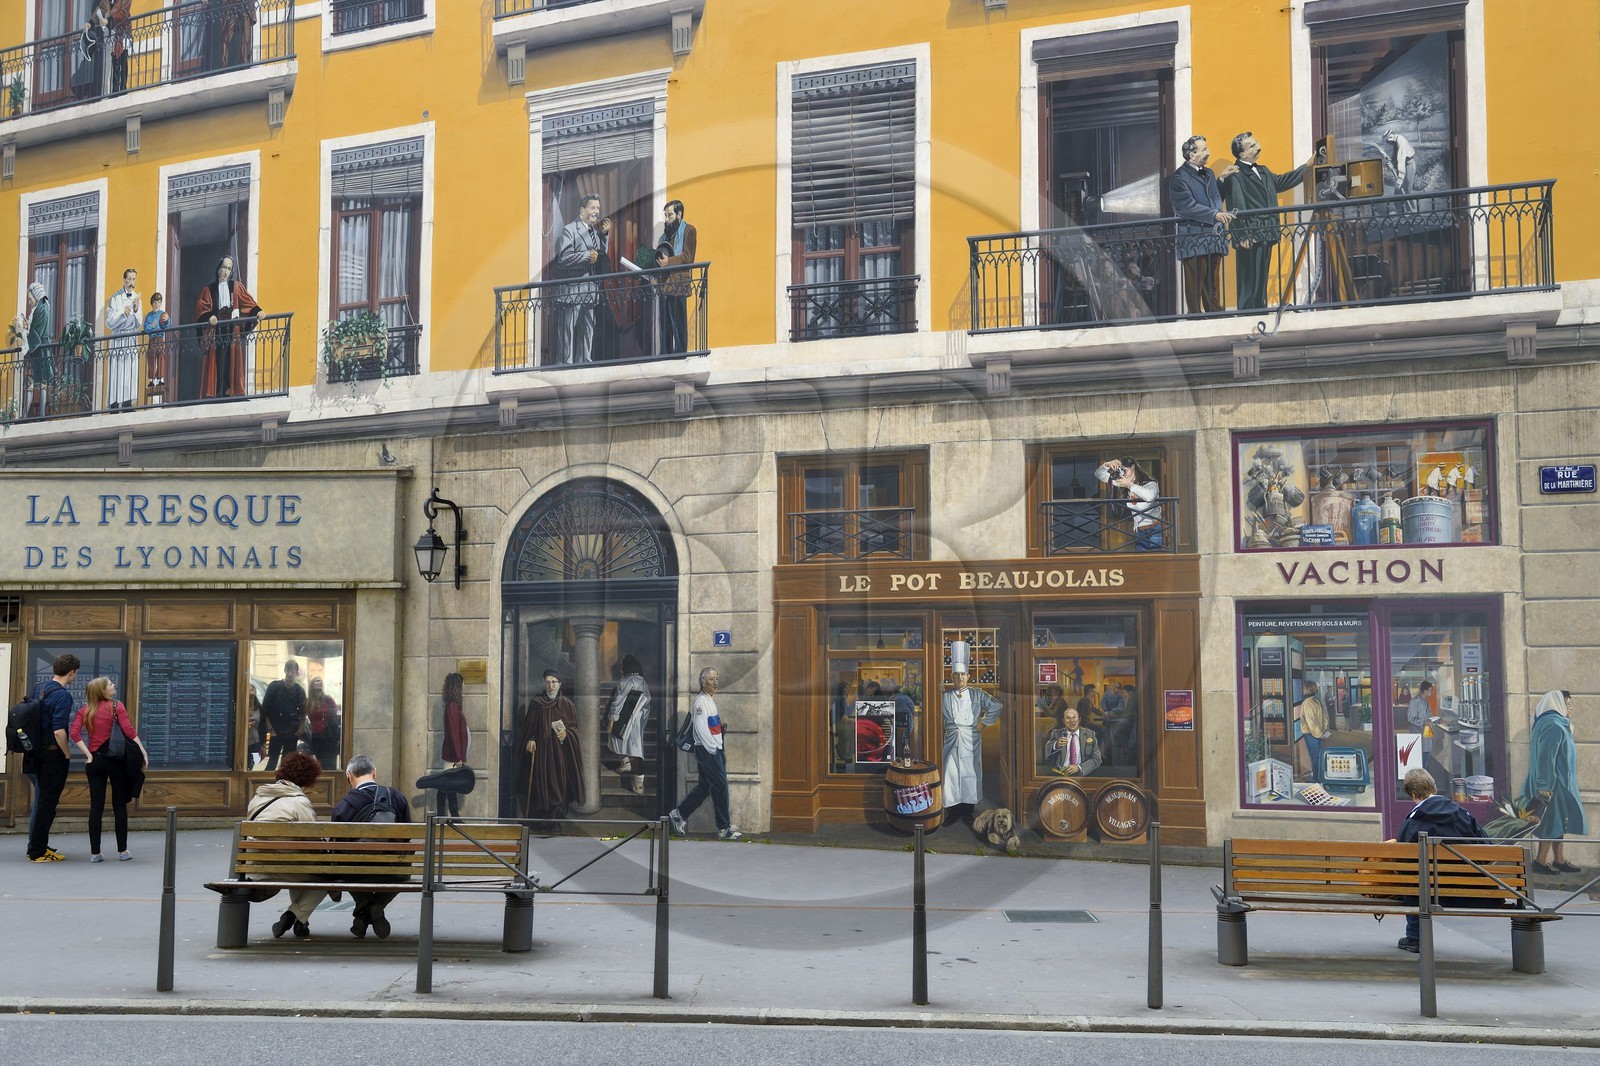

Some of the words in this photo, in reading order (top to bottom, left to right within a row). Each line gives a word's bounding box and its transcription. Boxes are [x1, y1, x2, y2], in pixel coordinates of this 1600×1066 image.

[1557, 479, 1593, 488] MARTINIÈRE
[26, 494, 80, 526] LA
[98, 494, 303, 529] FRESQUE
[24, 546, 92, 568] DES
[114, 546, 303, 569] LYONNAIS
[1275, 558, 1445, 586] VACHON
[838, 575, 871, 592] LE
[890, 573, 942, 591] POT
[959, 568, 1126, 590] BEAUJOLAIS
[718, 633, 726, 644] 2
[1048, 793, 1080, 806] BEAUJOLAIS
[1105, 791, 1137, 804] BEAUJOLAIS
[1108, 816, 1137, 829] VILLAGES
